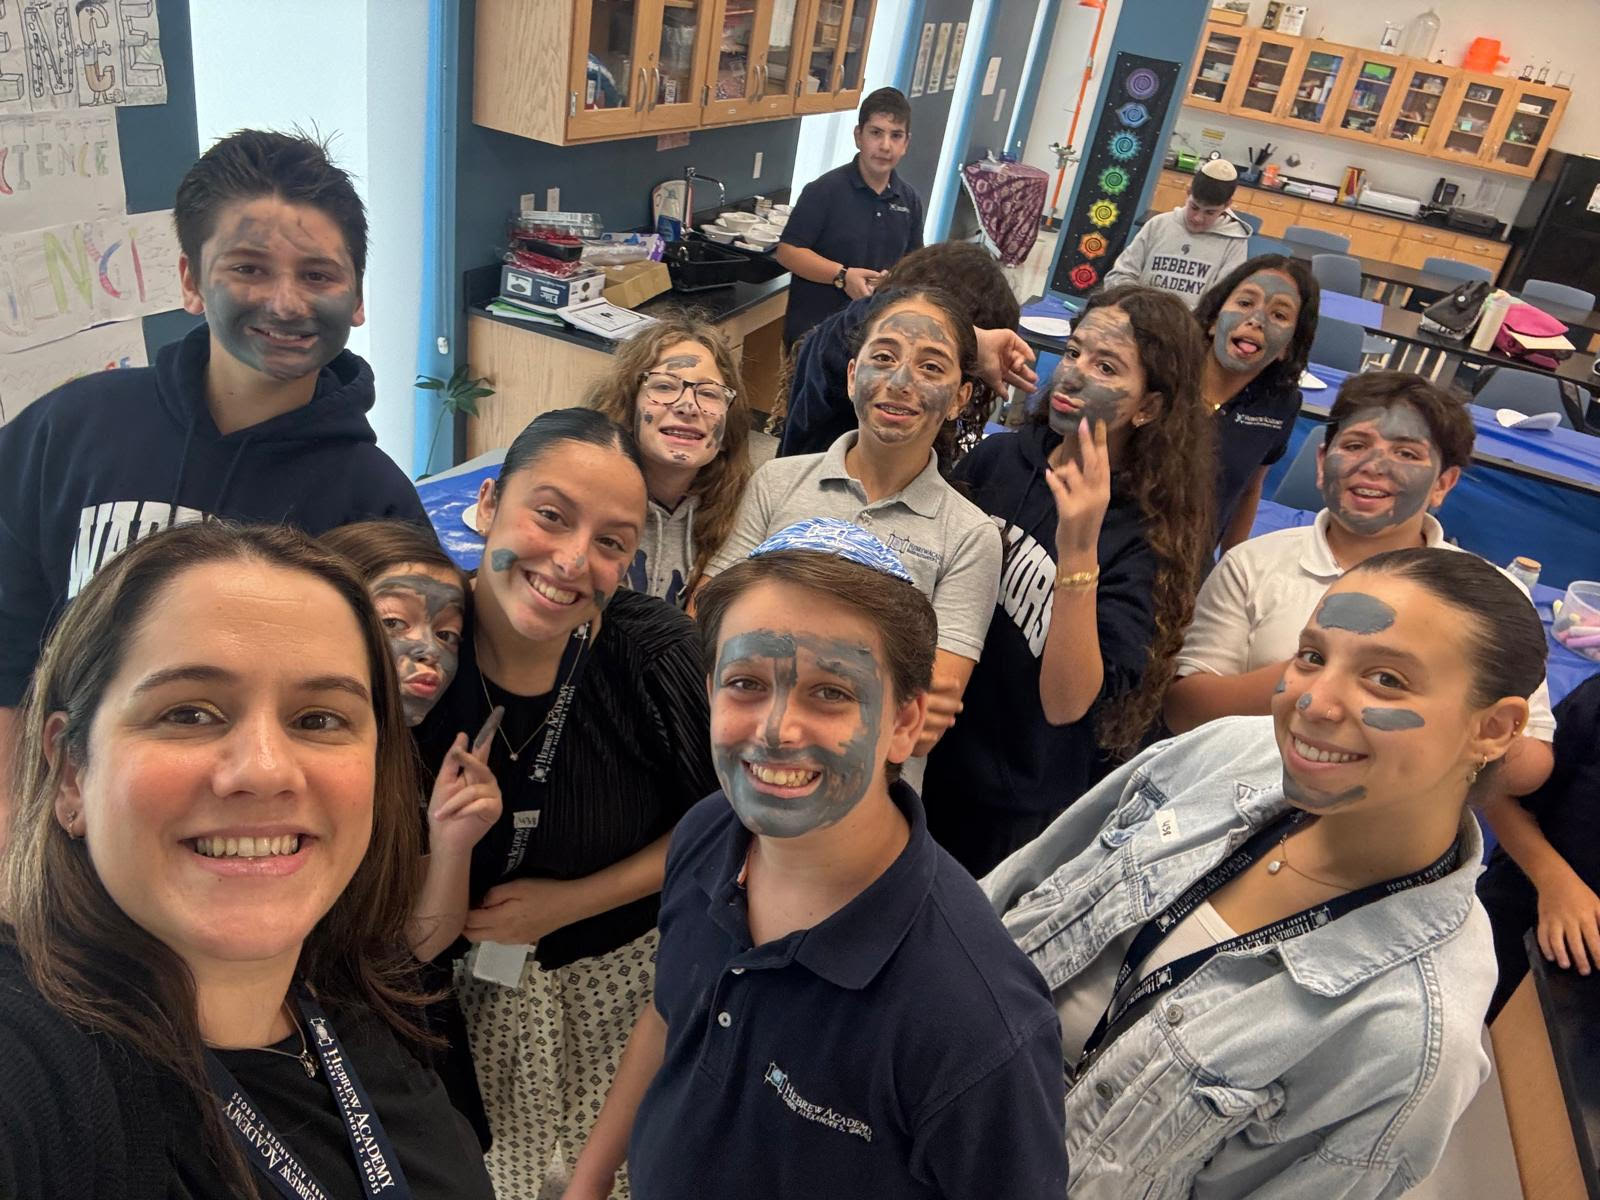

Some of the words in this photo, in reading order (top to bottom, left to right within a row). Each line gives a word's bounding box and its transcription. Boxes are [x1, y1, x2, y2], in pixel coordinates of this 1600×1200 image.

[1151, 255, 1212, 278] HEBREW
[535, 725, 555, 764] HEBREW
[1270, 922, 1311, 944] HEBREW
[232, 1092, 256, 1120] GROSS
[258, 1119, 265, 1131] S.
[326, 1048, 361, 1107] HEBREW
[354, 1112, 394, 1189] ACADEMY
[783, 1082, 824, 1114] HEBREW
[823, 1108, 872, 1136] ACADEMY
[222, 1101, 283, 1169] ACADEMY
[262, 1132, 306, 1178] ALEXANDER
[336, 1087, 366, 1142] ALEXANDER
[358, 1147, 365, 1158] S.
[364, 1161, 382, 1194] GROSS
